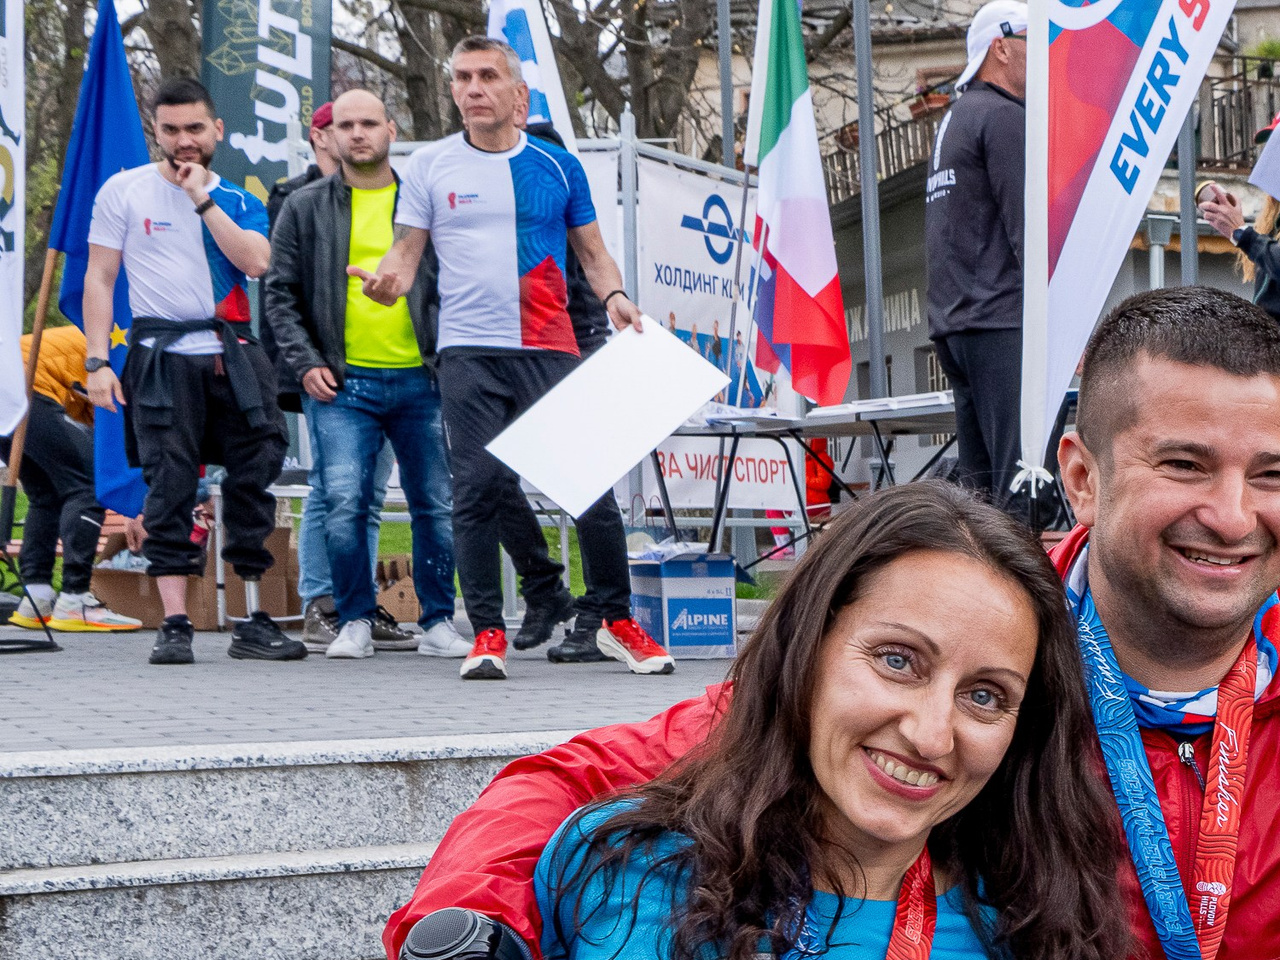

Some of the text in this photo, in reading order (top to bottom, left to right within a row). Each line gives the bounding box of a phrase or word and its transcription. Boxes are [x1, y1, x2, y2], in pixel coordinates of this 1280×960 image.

[301, 85, 313, 127] GOLD
[1109, 14, 1190, 196] EVERY
[654, 262, 719, 295] ХОЛДИНГ
[733, 456, 789, 485] СПОРТ
[671, 608, 729, 630] ALPINE
[1217, 721, 1240, 828] Finisher
[1118, 758, 1183, 934] EVERY STEP MATTERS
[1199, 895, 1210, 915] HILLS
[1206, 896, 1218, 926] PLOVDIV
